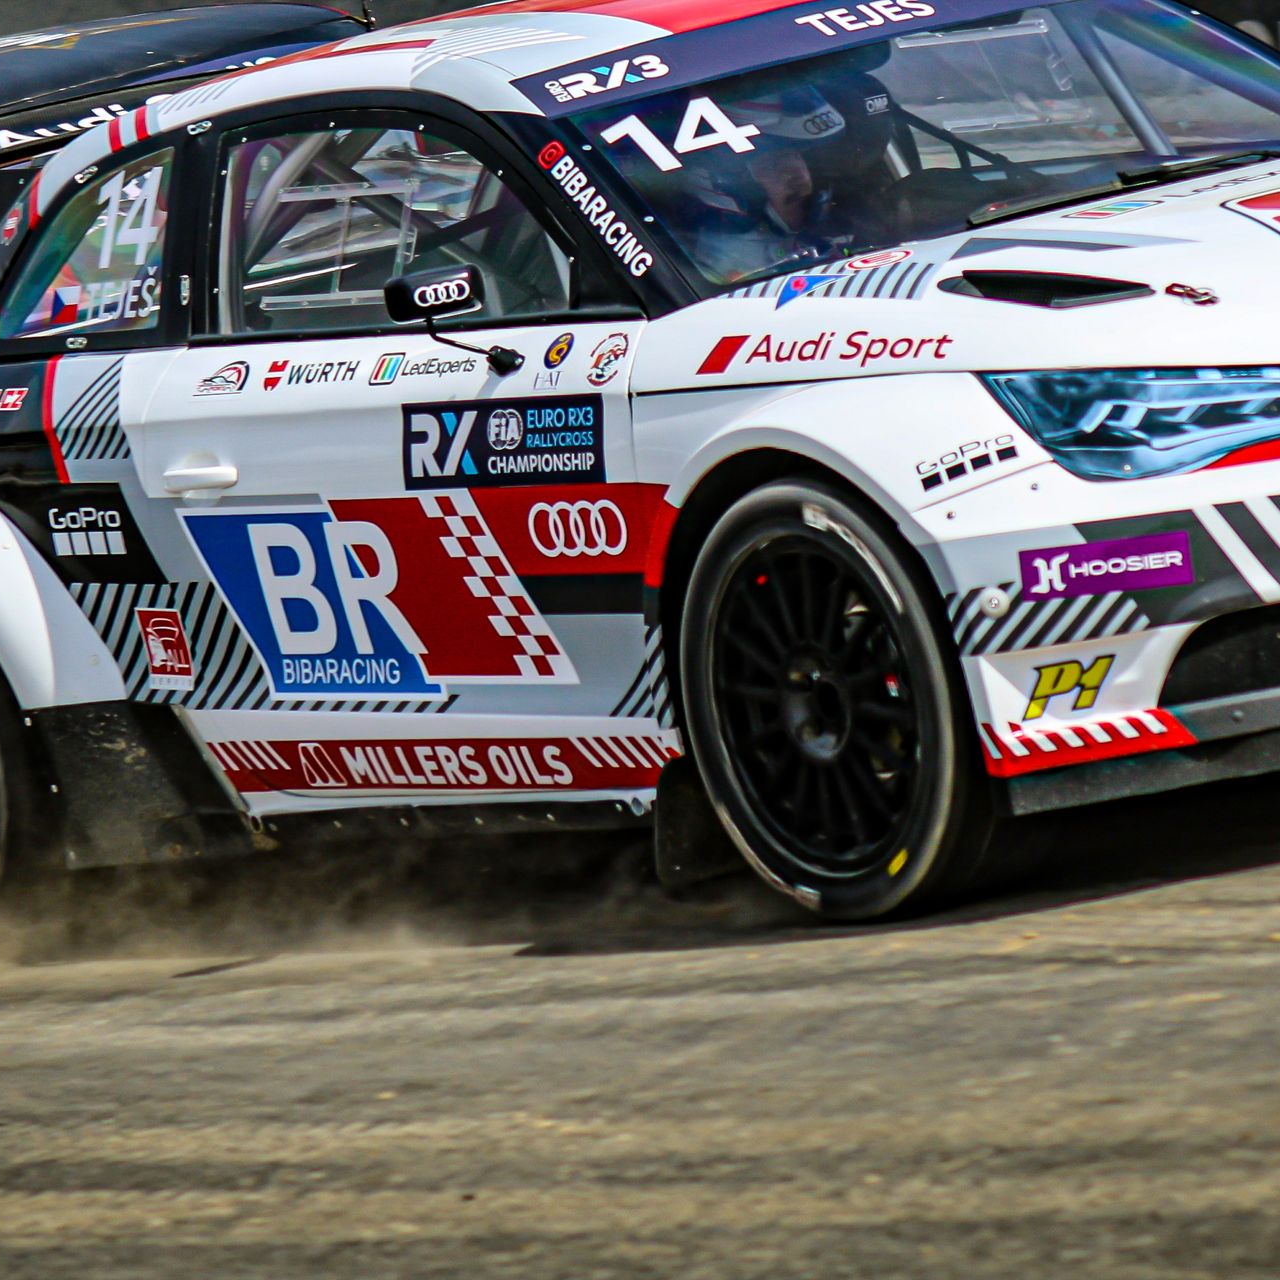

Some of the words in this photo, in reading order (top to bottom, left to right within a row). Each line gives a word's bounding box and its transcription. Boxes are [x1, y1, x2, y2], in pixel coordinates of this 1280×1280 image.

[545, 80, 572, 104] EURO
[558, 55, 670, 99] RX3
[600, 96, 761, 172] 14
[97, 166, 163, 269] 14
[551, 155, 653, 277] BIBARACING
[86, 266, 157, 320] TEJEŠ
[401, 357, 477, 378] LedExperts
[744, 332, 836, 365] Audi
[839, 330, 953, 368] Sport
[526, 408, 565, 429] EURO
[568, 406, 594, 427] RX3
[411, 410, 479, 478] RX
[526, 431, 594, 448] RALLYCROSS
[916, 433, 1014, 476] GoPro
[487, 452, 595, 475] CHAMPIONSHIP
[49, 507, 121, 530] GoPro
[1069, 550, 1184, 578] HOOSIER
[247, 521, 428, 655] BR
[282, 657, 401, 686] BIBARACING
[1022, 654, 1116, 722] P1
[340, 745, 487, 786] MILLERS
[489, 745, 574, 785] OILS
